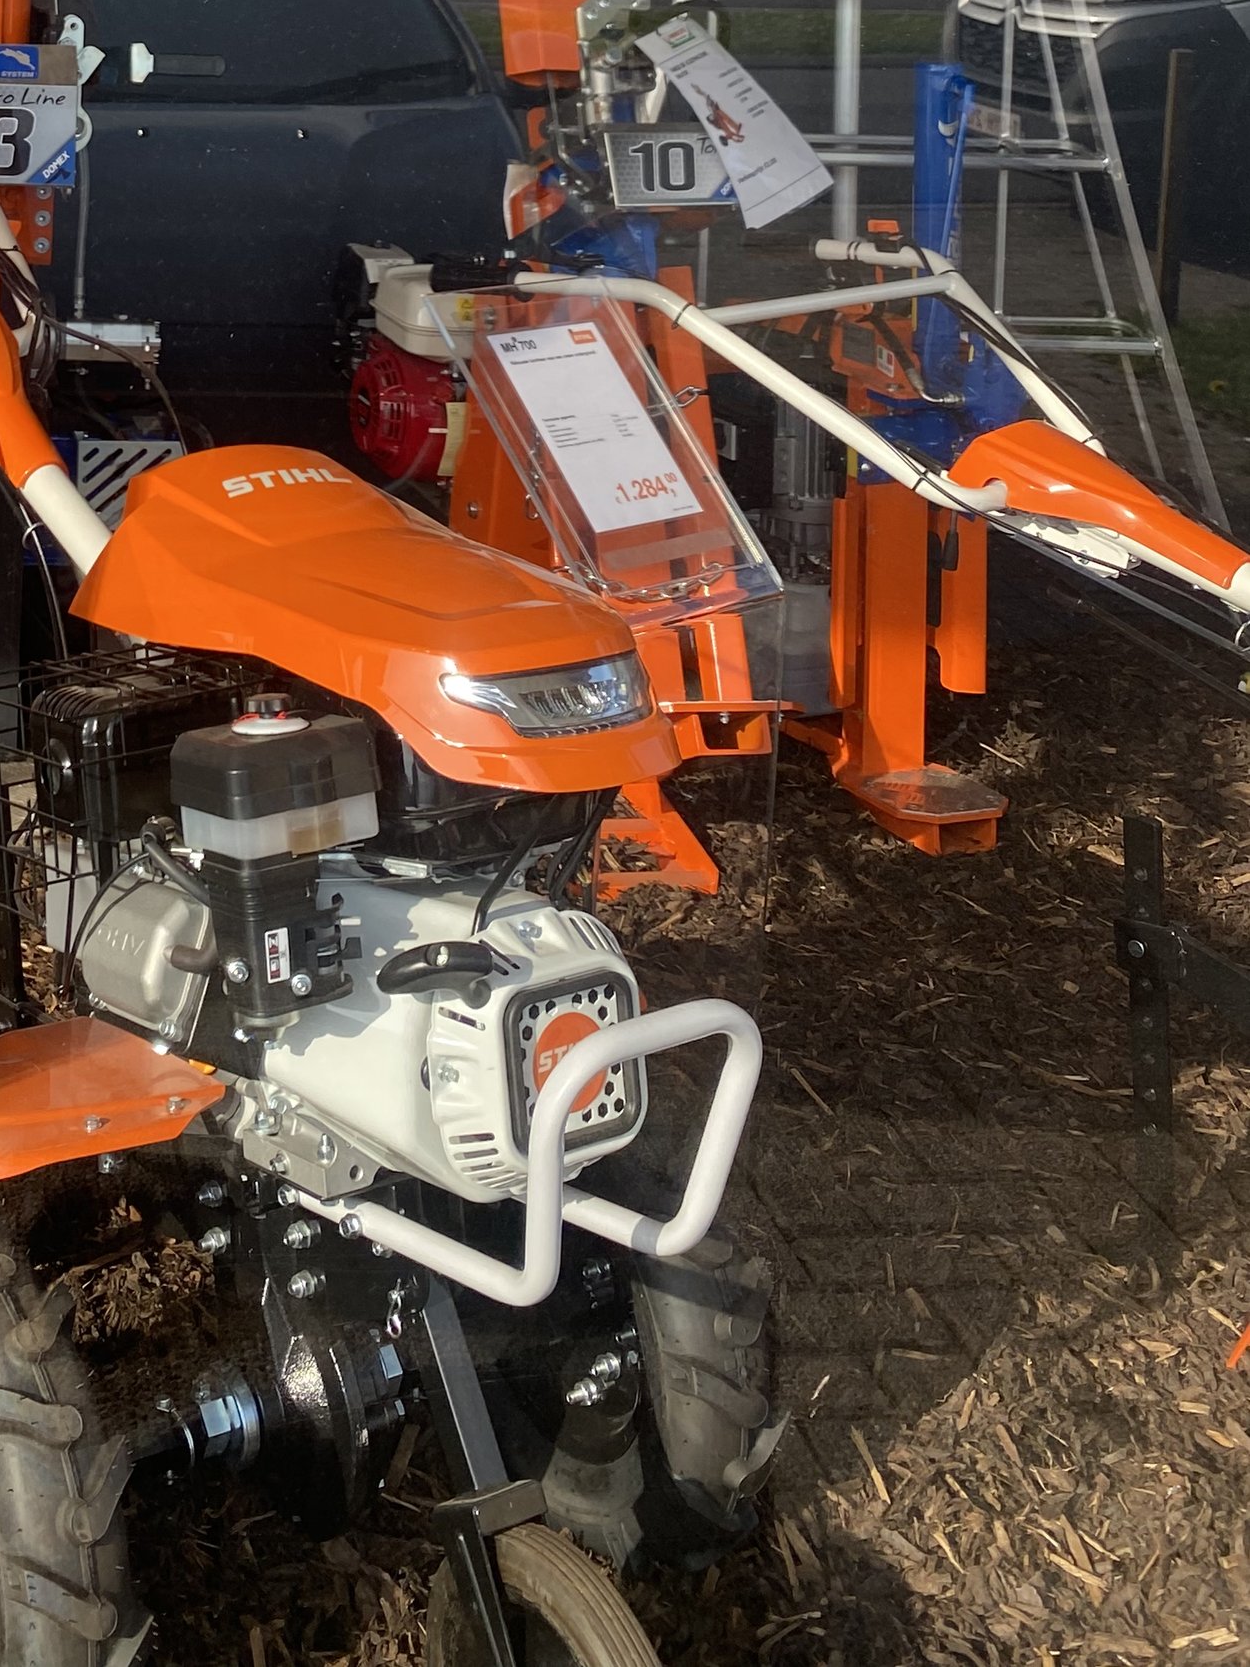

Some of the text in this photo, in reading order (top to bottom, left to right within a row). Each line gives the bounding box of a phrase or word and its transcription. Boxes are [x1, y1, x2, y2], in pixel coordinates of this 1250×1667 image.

[21, 87, 66, 106] Line
[42, 151, 70, 179] DOMEX
[629, 140, 696, 192] 10
[696, 136, 717, 154] To
[518, 339, 538, 351] 700
[222, 468, 352, 498] STIHL
